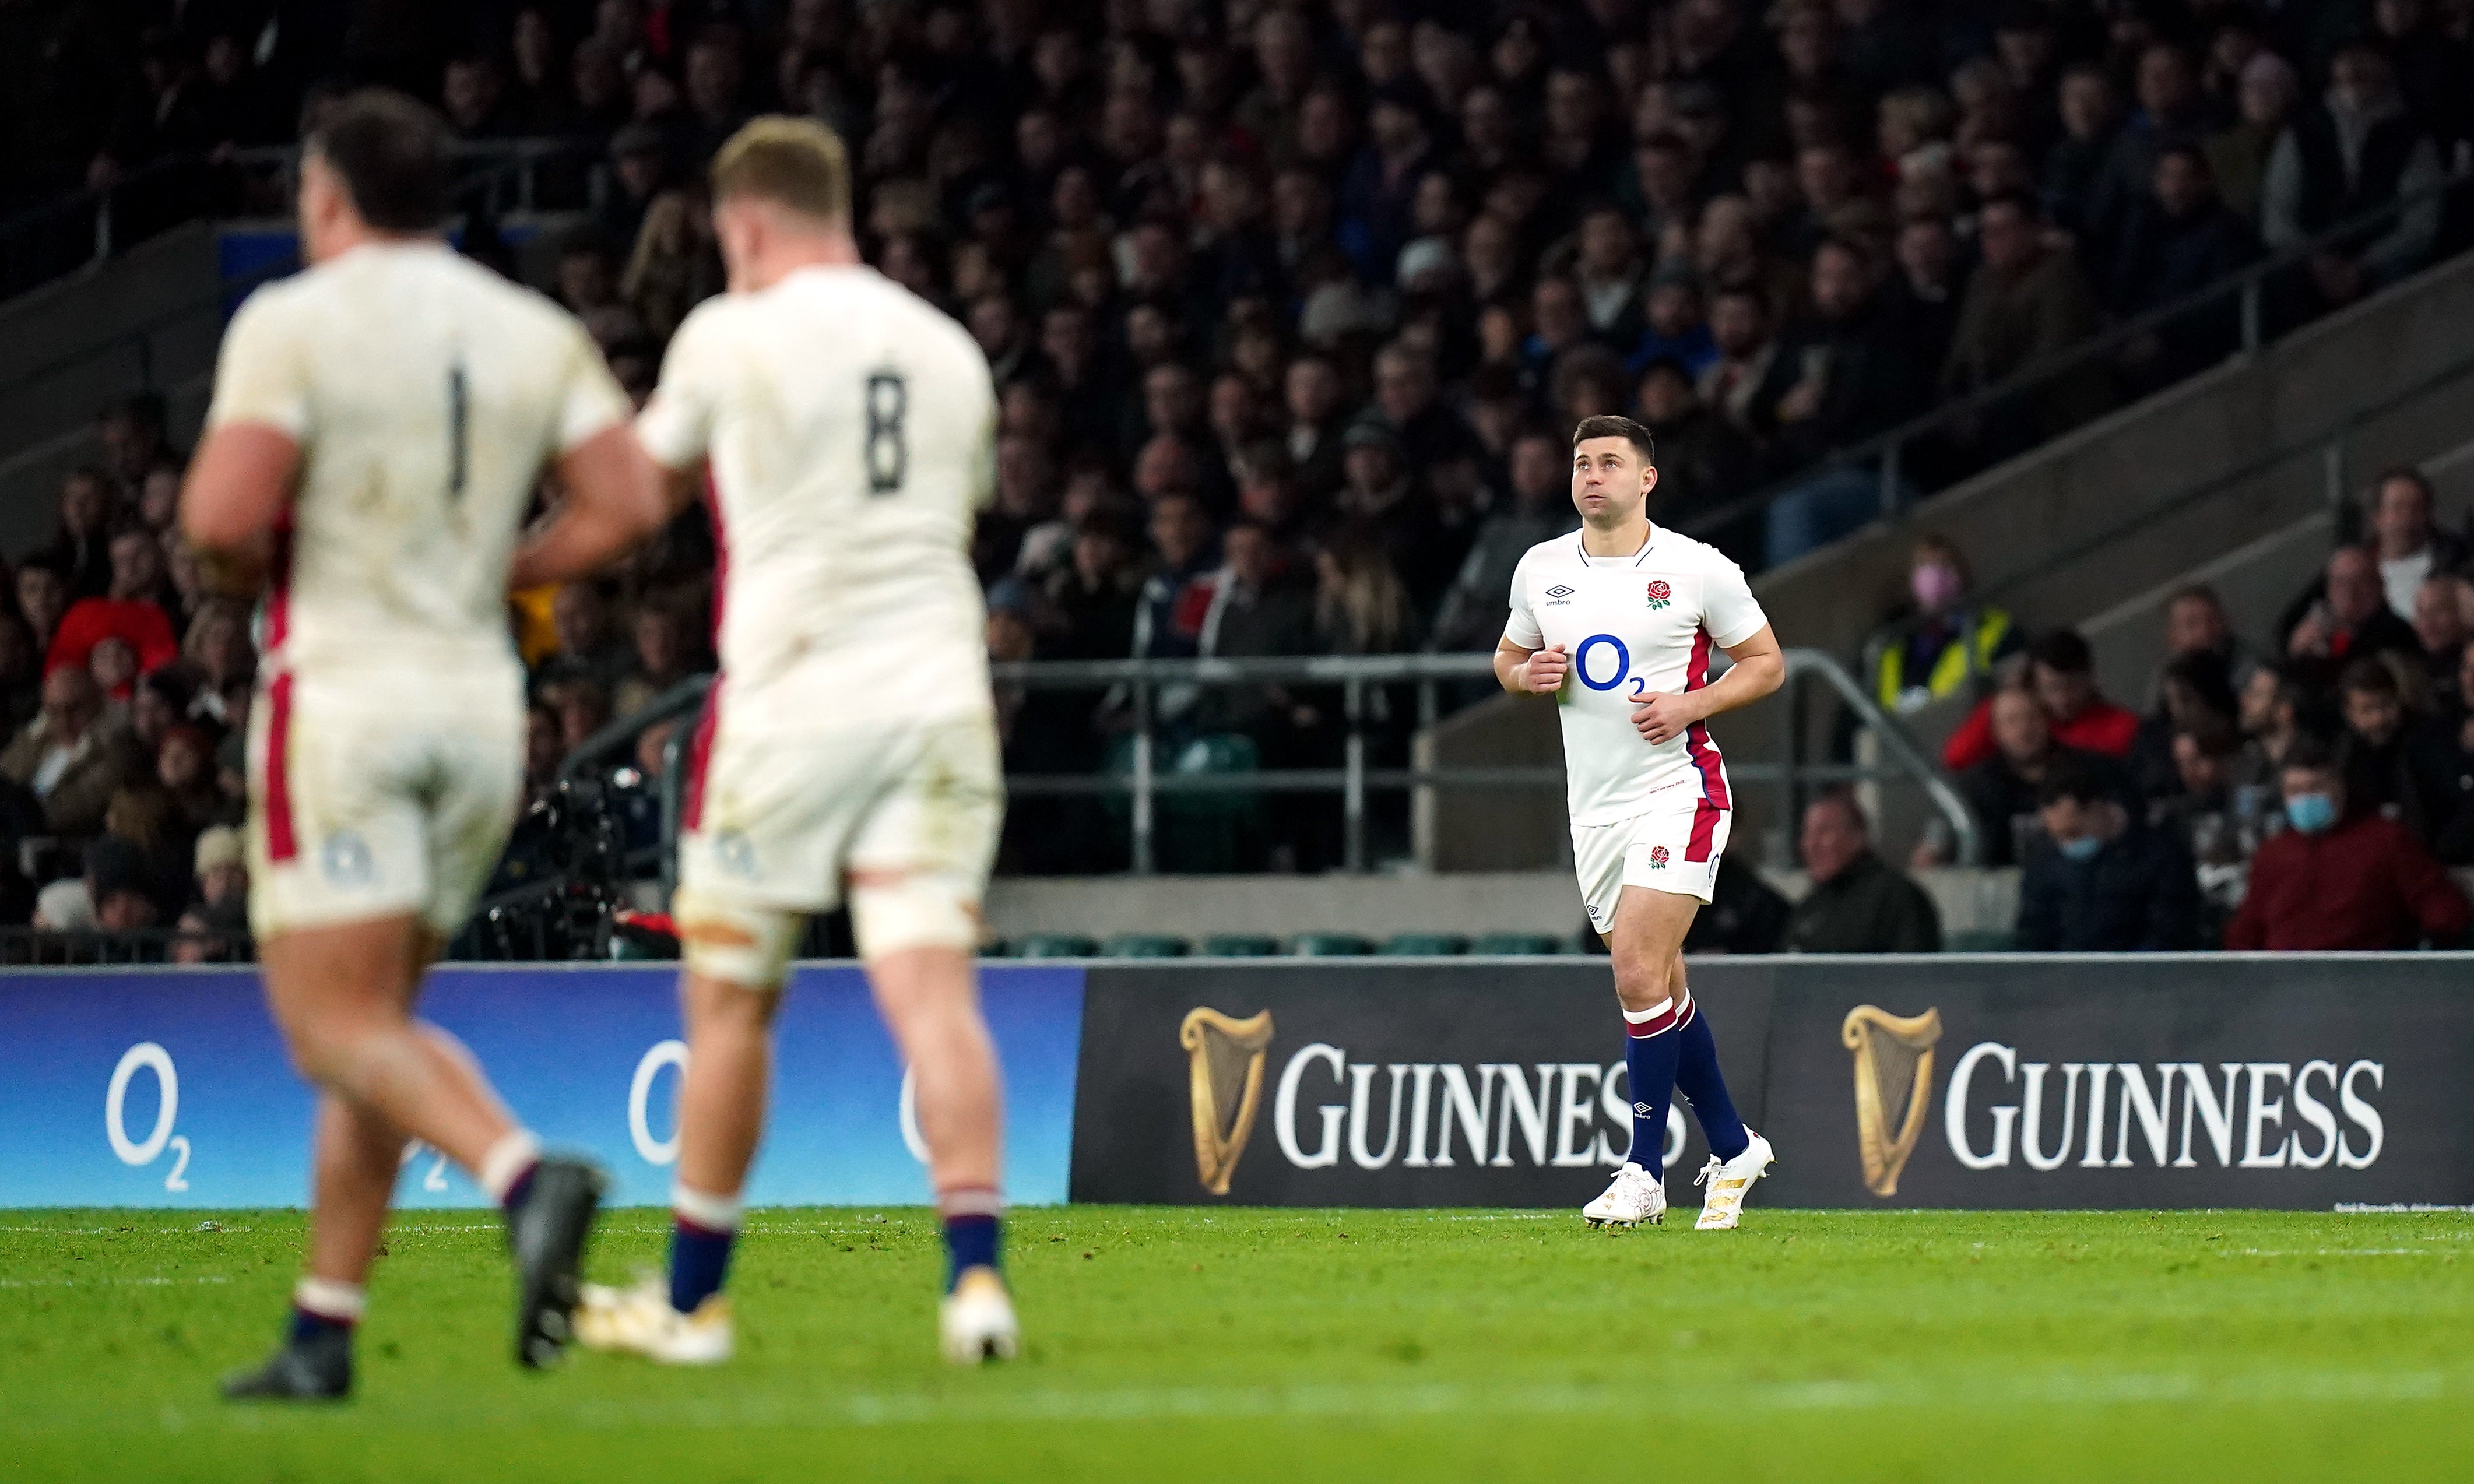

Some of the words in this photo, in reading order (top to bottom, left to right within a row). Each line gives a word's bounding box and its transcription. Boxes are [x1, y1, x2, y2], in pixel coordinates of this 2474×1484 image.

[448, 364, 469, 495] 1
[865, 373, 909, 495] 8
[1575, 634, 1645, 696] O2
[105, 1041, 191, 1193] O2
[1944, 1042, 2385, 1170] GUINNESS
